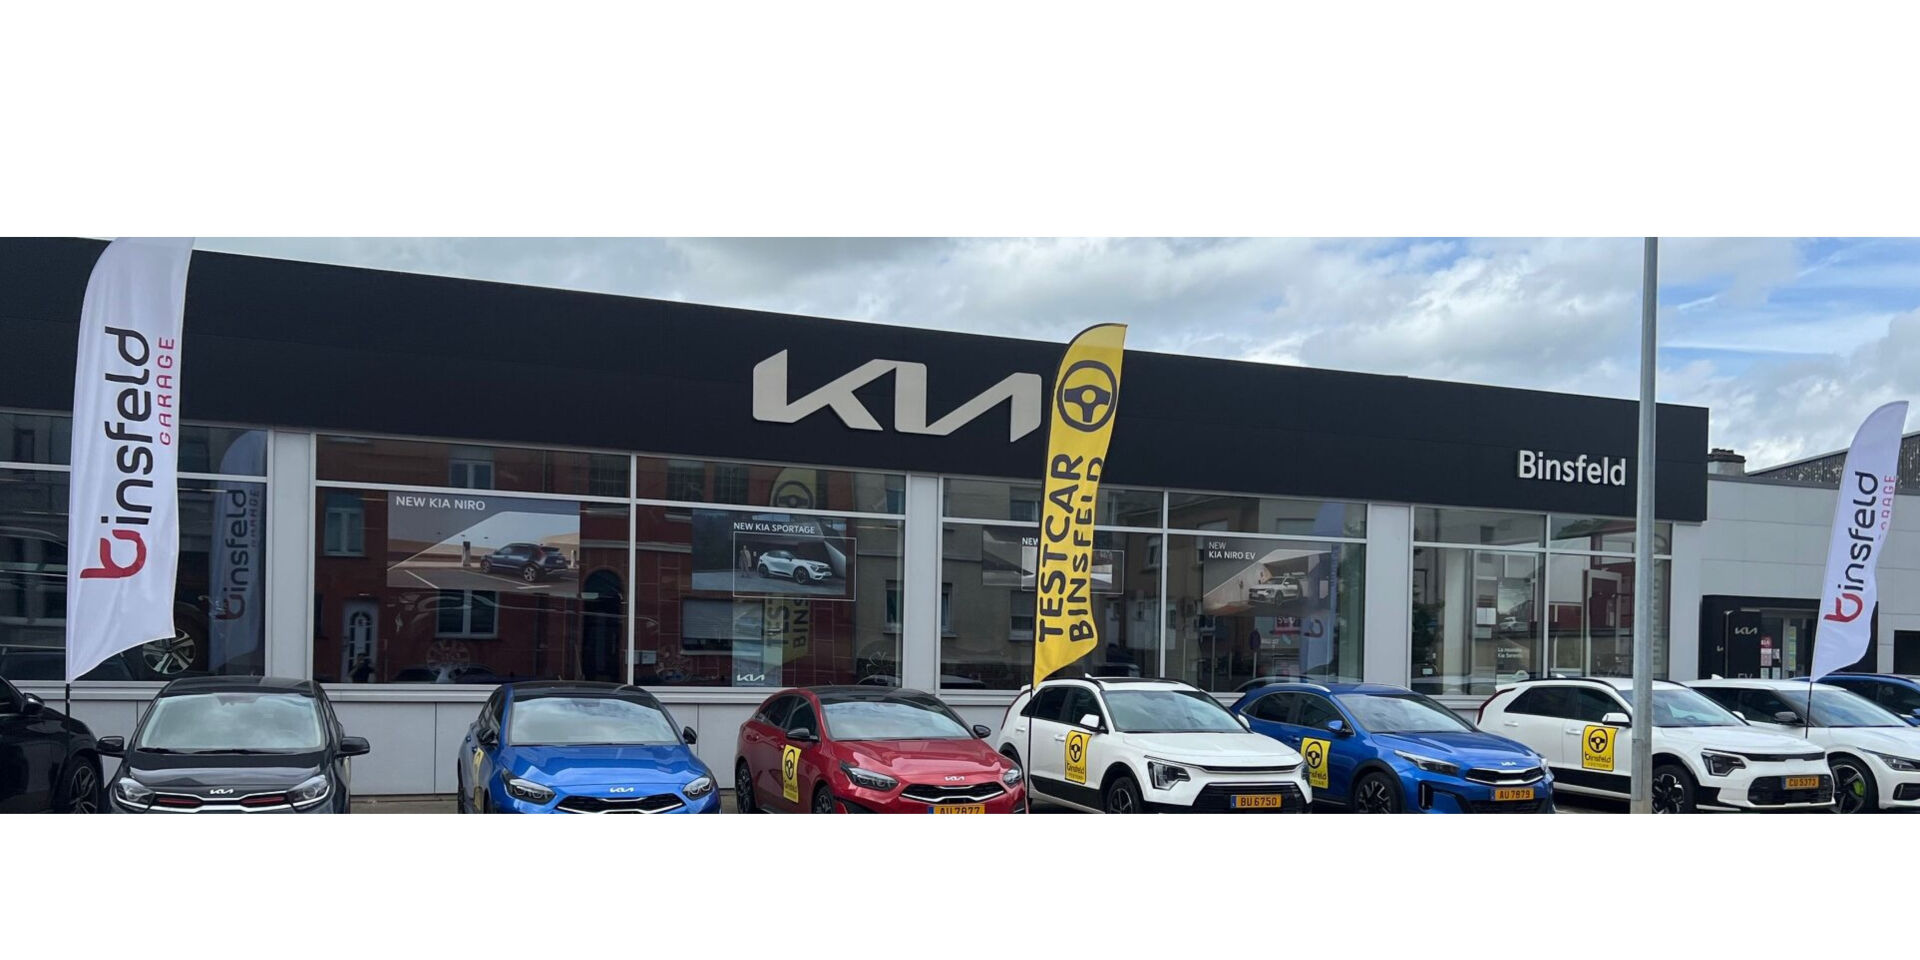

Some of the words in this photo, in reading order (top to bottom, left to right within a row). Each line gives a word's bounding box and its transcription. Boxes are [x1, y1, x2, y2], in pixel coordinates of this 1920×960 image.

[155, 336, 175, 446] GARAGE
[752, 349, 1042, 443] KIA
[1518, 449, 1626, 486] Binsfeld
[396, 495, 426, 508] NEW
[429, 497, 451, 509] KIA
[454, 499, 486, 511] NIRO
[1878, 474, 1896, 541] RAGE
[733, 521, 754, 531] NEW
[755, 522, 770, 532] KIA
[771, 523, 816, 535] SPORTAGE
[1039, 453, 1084, 643] TESTCAR
[1208, 541, 1227, 550] NEW
[1208, 550, 1223, 559] KIA
[1223, 551, 1244, 560] NIRO
[1245, 551, 1256, 560] EV
[736, 673, 766, 683] KIA
[1240, 797, 1253, 807] BU
[1254, 797, 1278, 807] 6750
